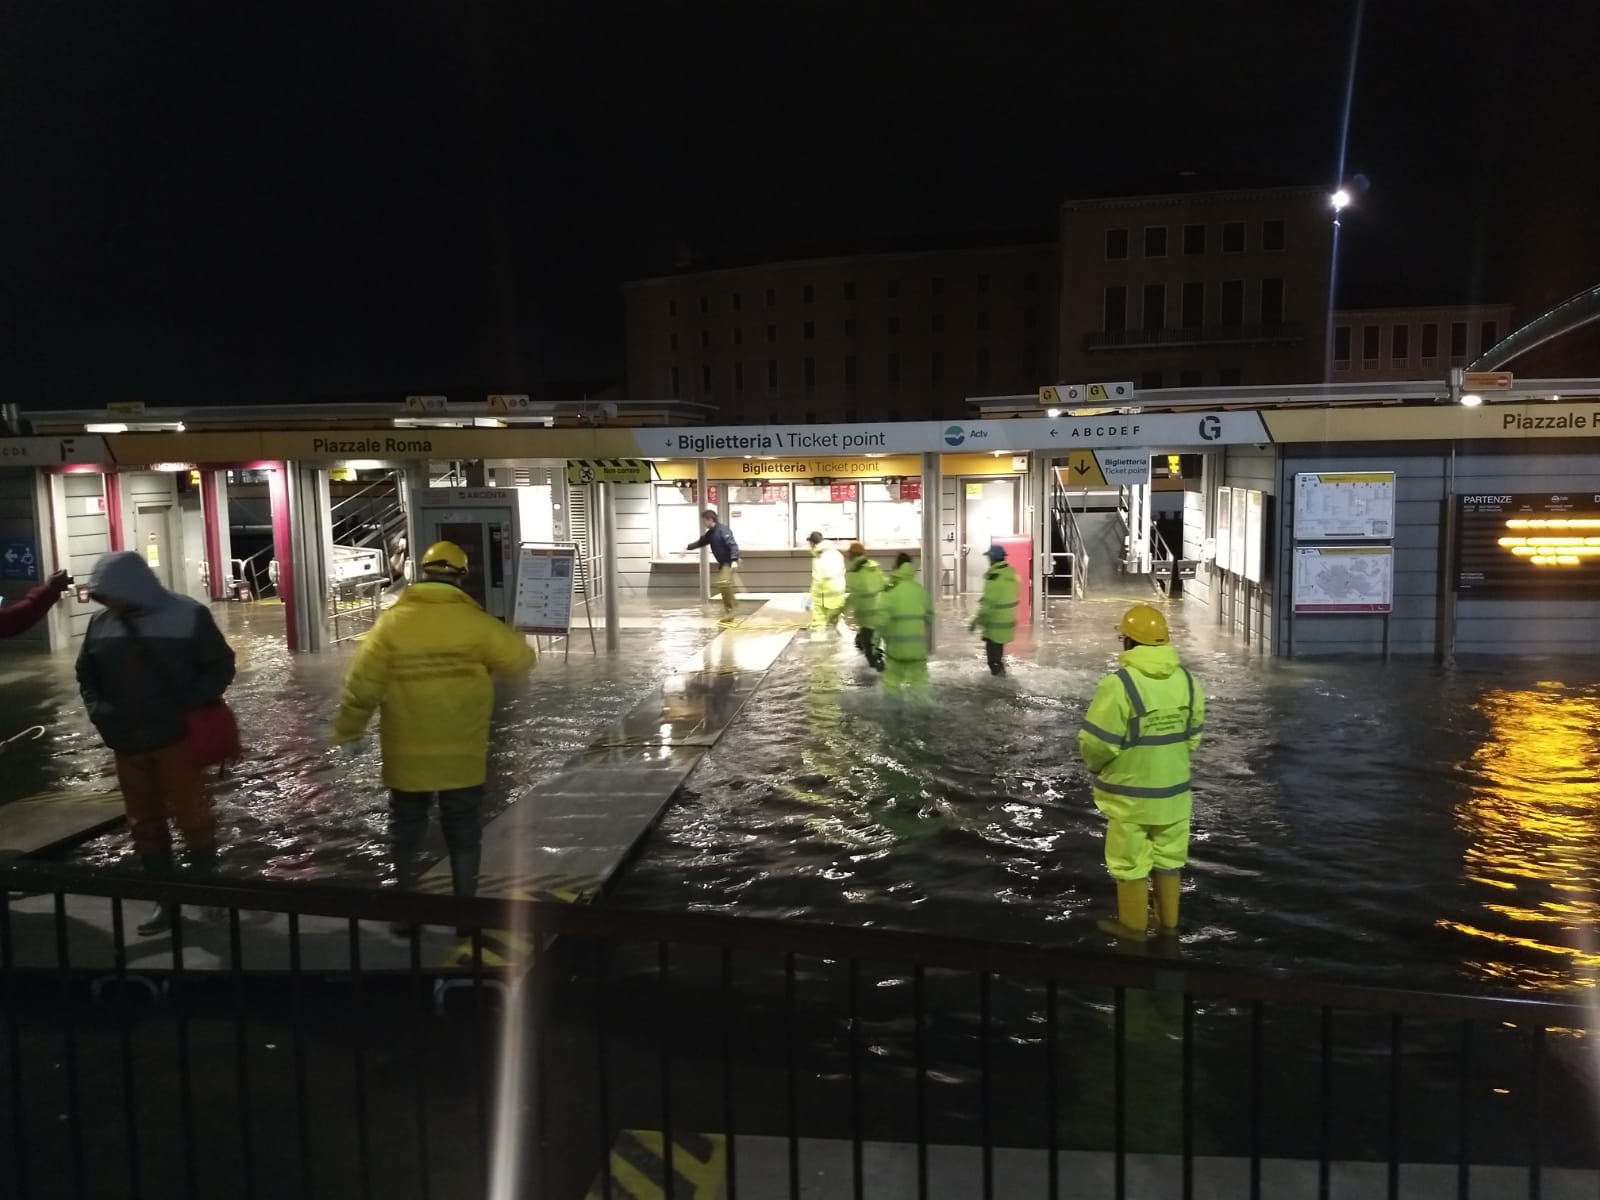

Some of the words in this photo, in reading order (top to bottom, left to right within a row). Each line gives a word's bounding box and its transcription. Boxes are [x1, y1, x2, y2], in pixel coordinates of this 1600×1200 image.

[1043, 388, 1052, 400] G
[1090, 385, 1099, 395] G
[1198, 415, 1221, 440] G
[1503, 412, 1587, 430] Piazzale
[313, 438, 381, 453] Piazzale
[385, 438, 432, 452] Roma
[678, 433, 772, 452] Biglietteria
[786, 431, 838, 447] Ticket
[842, 431, 886, 449] point
[60, 439, 75, 461] F
[742, 461, 806, 475] Biglietteria
[815, 461, 848, 472] Ticket
[850, 460, 880, 473] point
[1104, 458, 1147, 467] Biglietteria
[1128, 467, 1147, 475] point
[1463, 495, 1512, 504] PARTENZE
